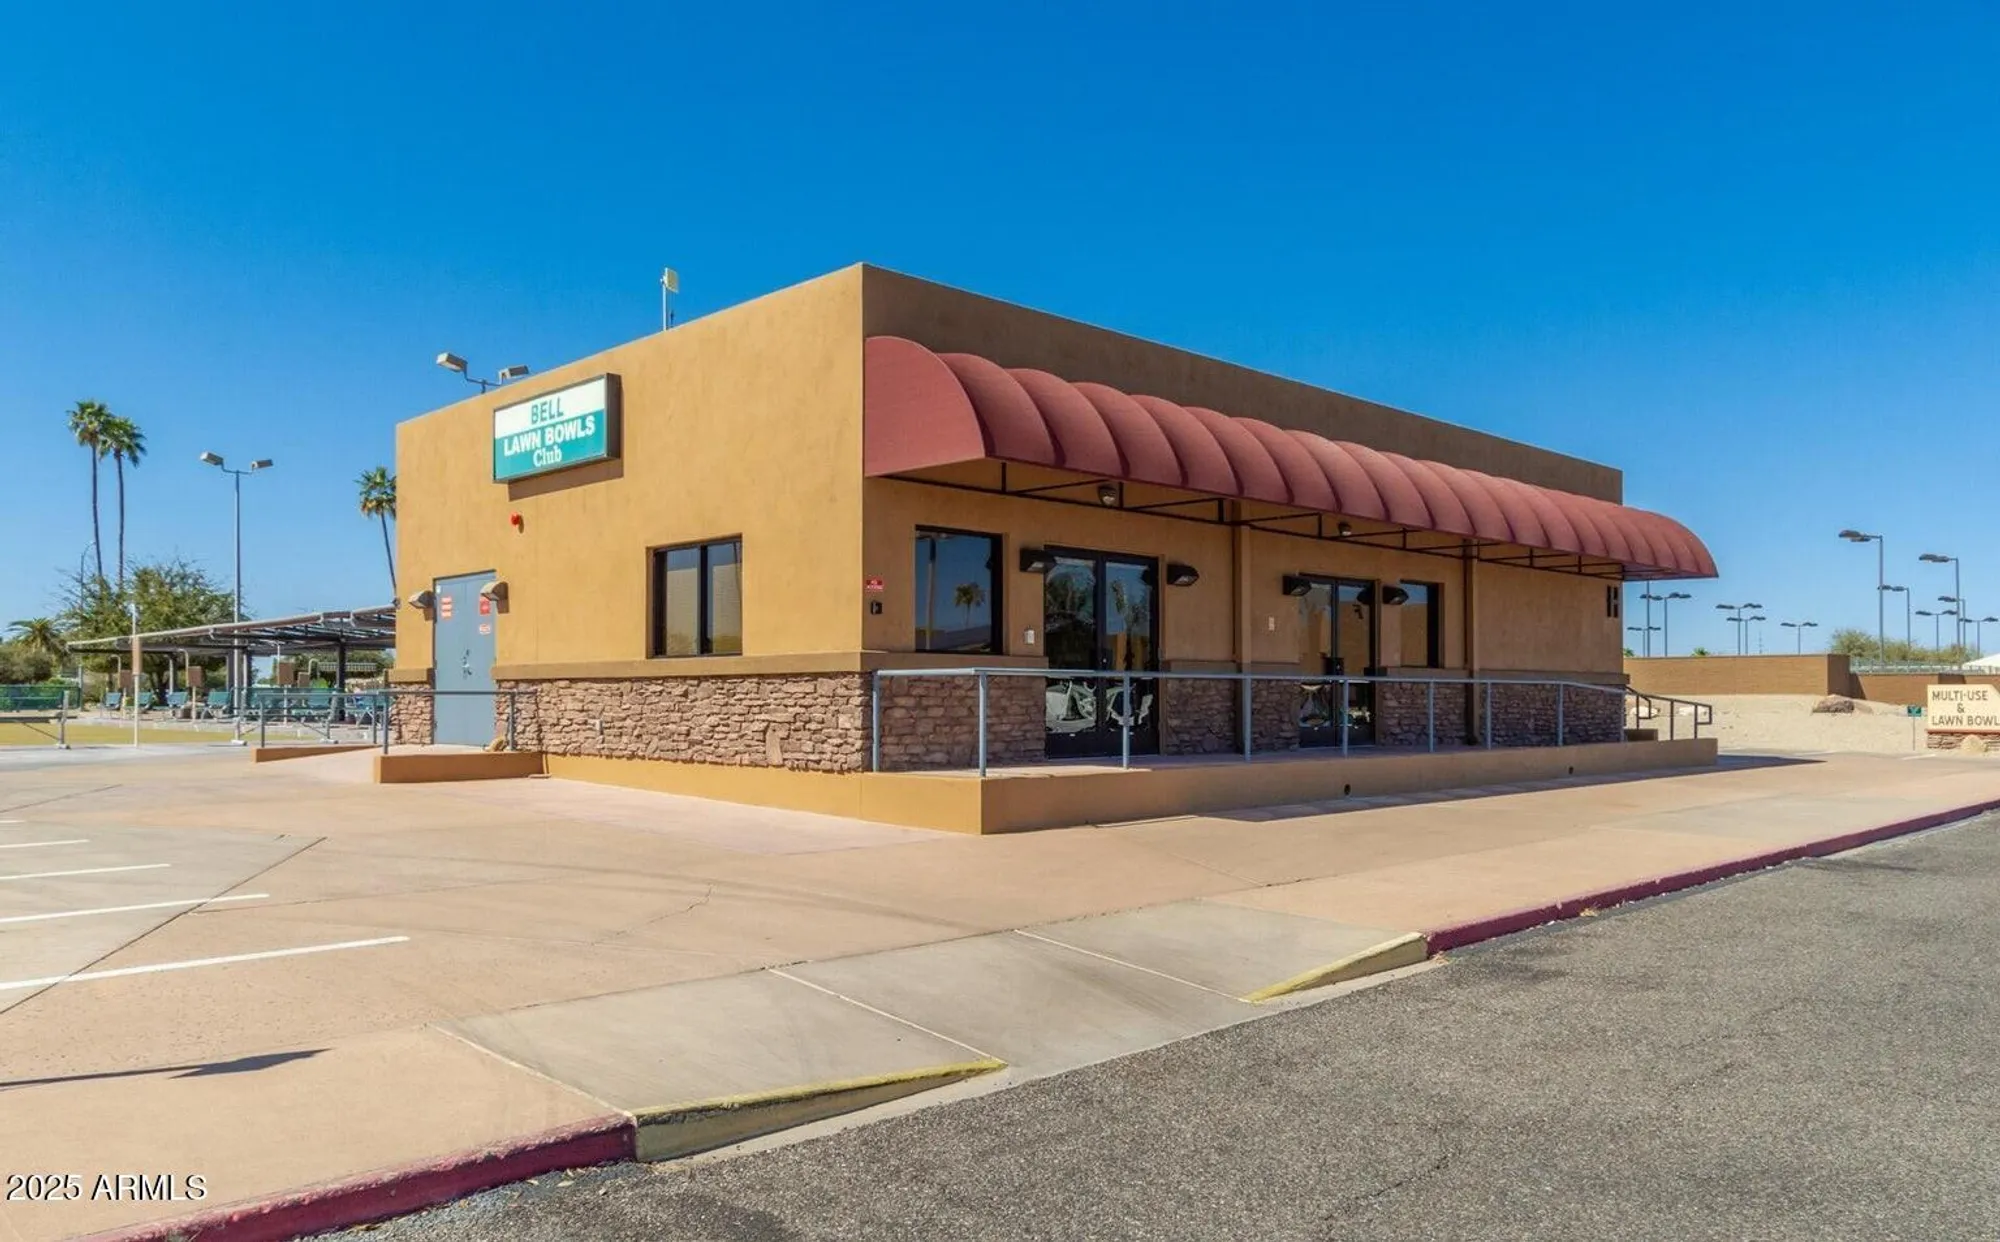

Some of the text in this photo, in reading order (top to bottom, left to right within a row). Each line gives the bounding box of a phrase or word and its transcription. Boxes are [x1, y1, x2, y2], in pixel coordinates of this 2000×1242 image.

[531, 396, 565, 425] BELL
[503, 415, 596, 456] LAWN BOWLS
[533, 445, 563, 467] Club
[1932, 690, 1988, 702] MULTI-USE
[1956, 703, 1965, 713] &
[1932, 715, 2000, 726] LAWN BOWL
